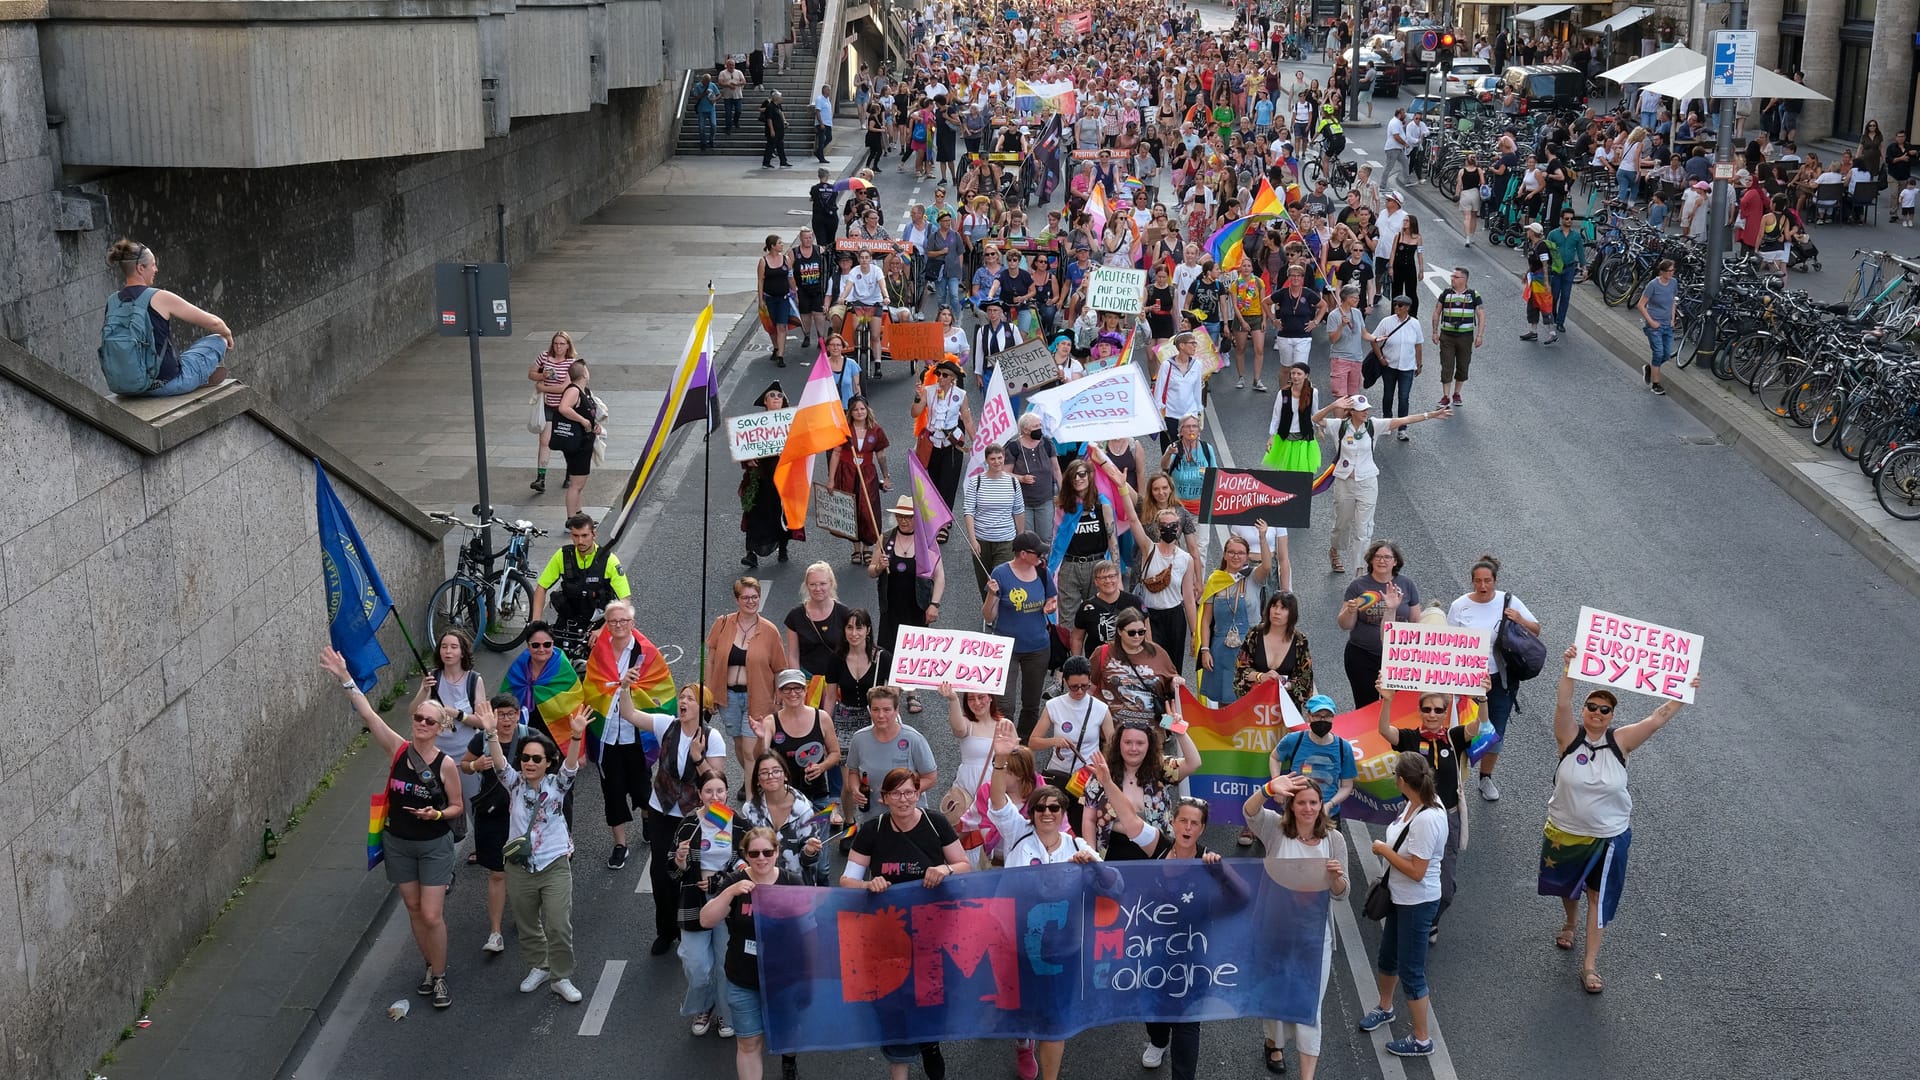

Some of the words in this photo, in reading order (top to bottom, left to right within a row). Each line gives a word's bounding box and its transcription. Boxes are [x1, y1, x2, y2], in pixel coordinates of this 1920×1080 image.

[1094, 270, 1140, 285] MEUTEREI
[1097, 285, 1111, 294] AUF
[1116, 287, 1132, 296] DER
[1092, 295, 1138, 311] LINDNER
[998, 347, 1047, 370] BREITSEITE
[1001, 366, 1029, 381] GEGEN
[737, 416, 769, 429] save
[736, 424, 791, 446] MERMAI
[757, 446, 784, 456] JETZ
[1218, 475, 1260, 490] WOMEN
[1215, 492, 1270, 511] SUPPORTING
[1075, 520, 1100, 534] VANS
[902, 632, 954, 652] HAPPY
[959, 638, 1005, 658] PRIDE
[1398, 630, 1420, 645] AM
[1424, 631, 1480, 649] HUMAN
[1590, 613, 1691, 655] EASTERN
[1388, 647, 1451, 665] NOTHING
[1455, 655, 1488, 669] MORE
[1585, 633, 1690, 674] EUROPEAN
[896, 657, 952, 677] EVERY
[955, 662, 1003, 687] DAY!
[1386, 666, 1421, 682] THEN
[1580, 652, 1686, 699] DYKE
[1253, 704, 1282, 726] SIS
[1232, 729, 1279, 751] STAN
[1213, 781, 1249, 796] LGBTI
[837, 897, 1070, 1009] DMC
[1093, 927, 1208, 961] March
[1092, 960, 1239, 999] Cologne
